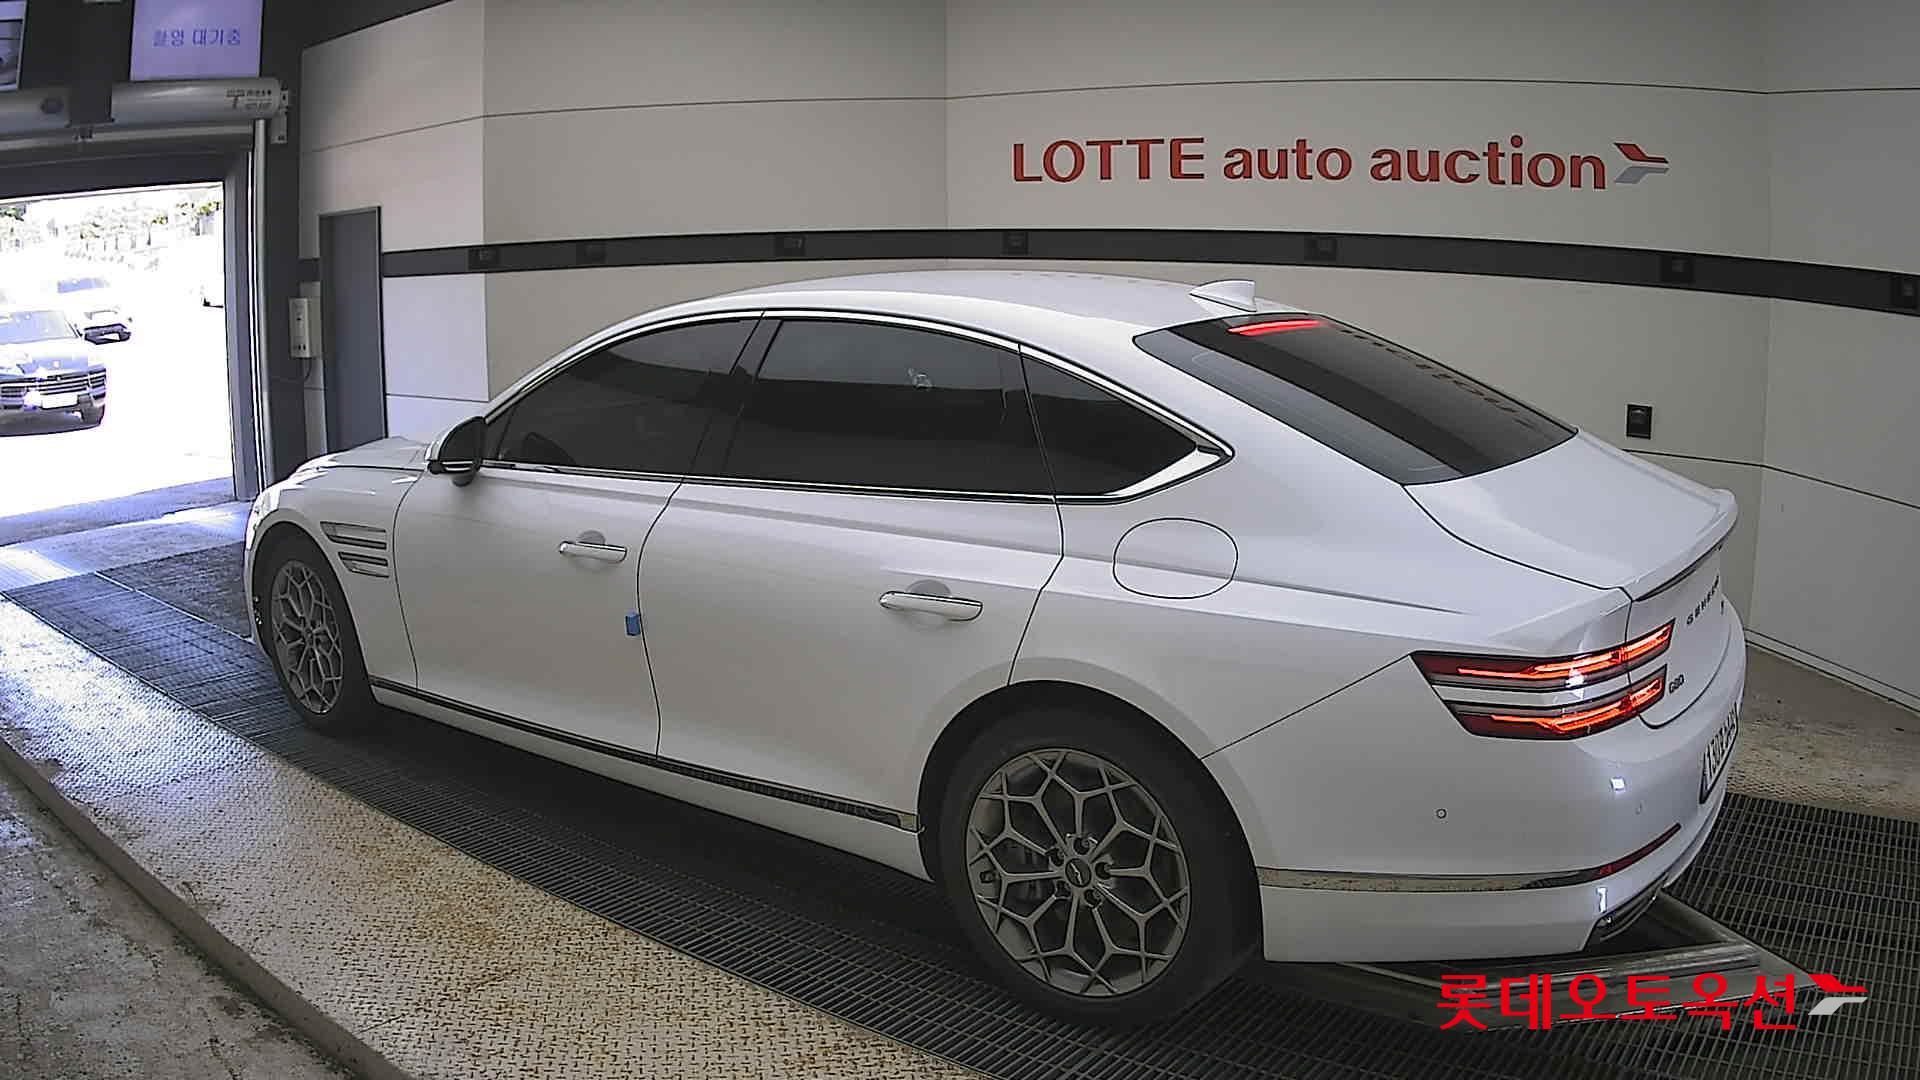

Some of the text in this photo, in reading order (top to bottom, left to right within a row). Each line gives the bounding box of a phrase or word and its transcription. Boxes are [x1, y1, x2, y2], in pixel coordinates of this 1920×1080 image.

[1013, 135, 1606, 190] LOTTE auto auction
[1686, 574, 1719, 625] GENE
